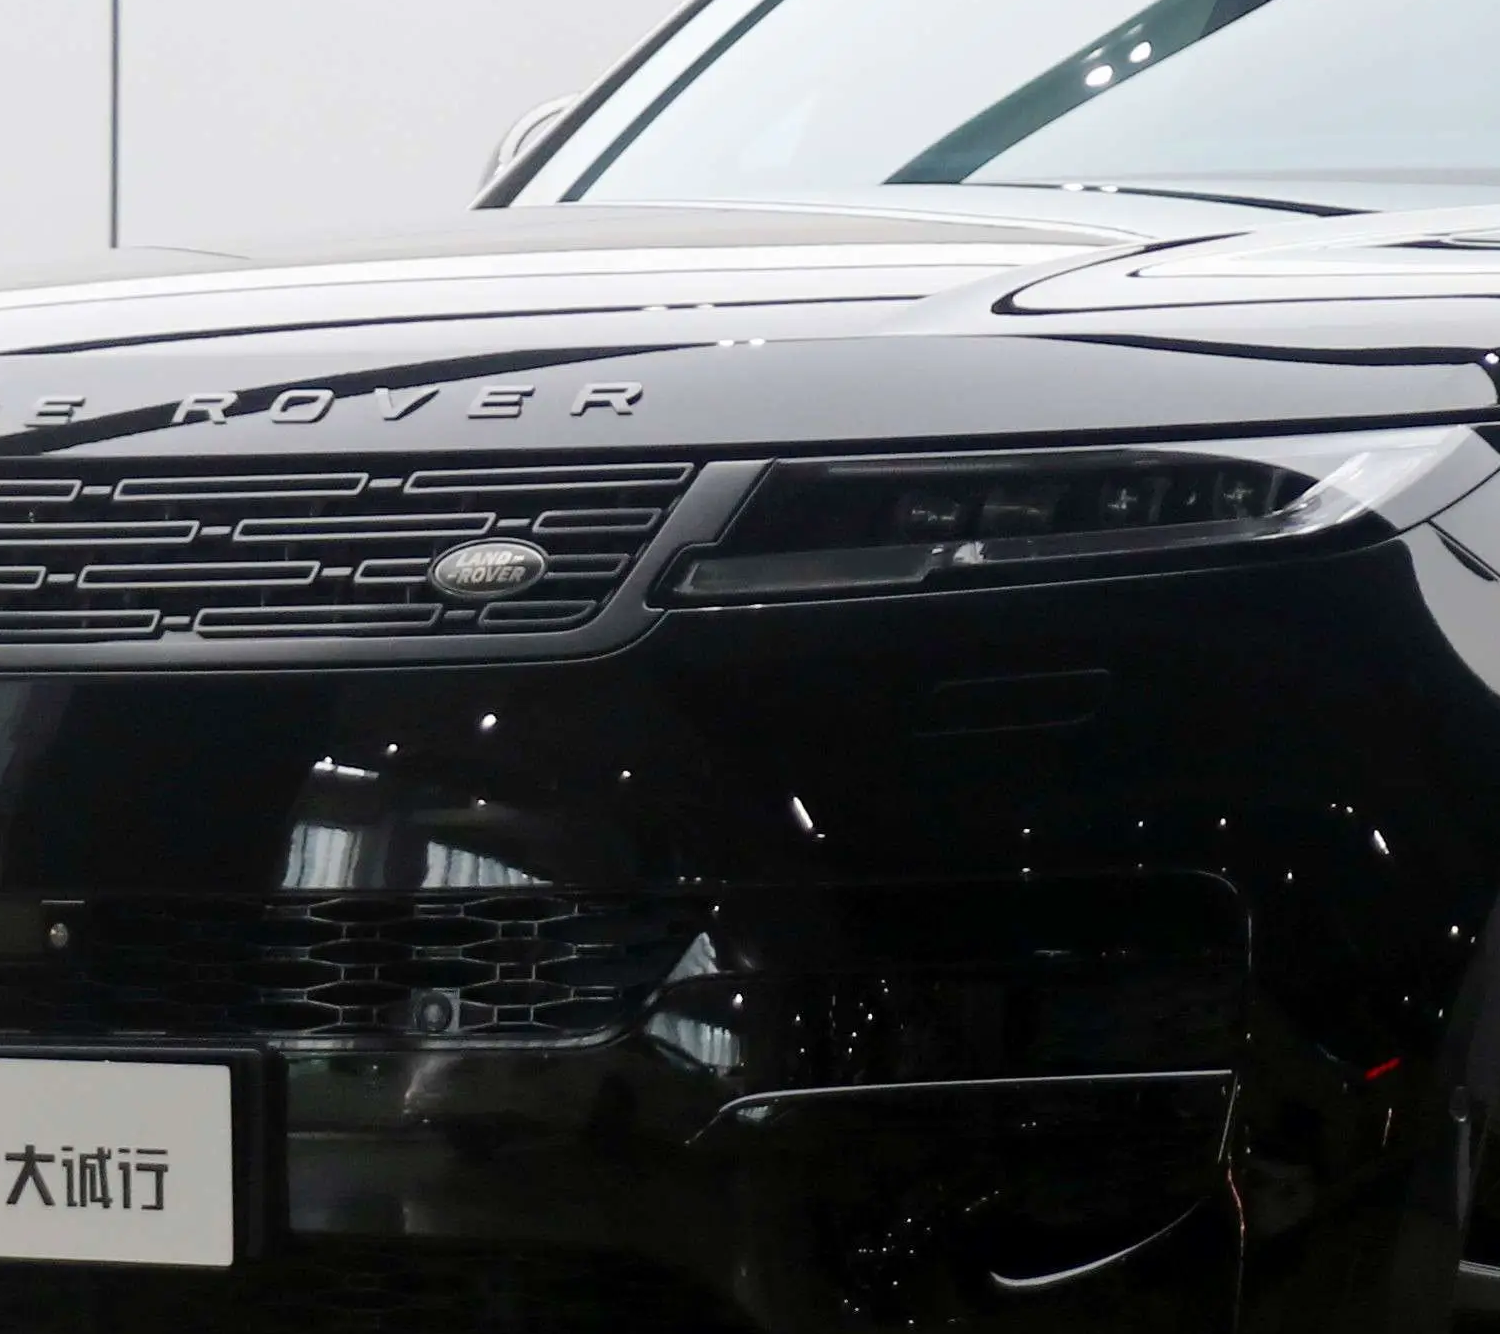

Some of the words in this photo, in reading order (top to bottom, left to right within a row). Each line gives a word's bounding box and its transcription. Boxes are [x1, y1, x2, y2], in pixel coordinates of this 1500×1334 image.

[171, 381, 645, 425] ROVER
[456, 551, 513, 566] LAND
[455, 565, 527, 584] ROVER
[4, 1143, 169, 1212] 大诚行
